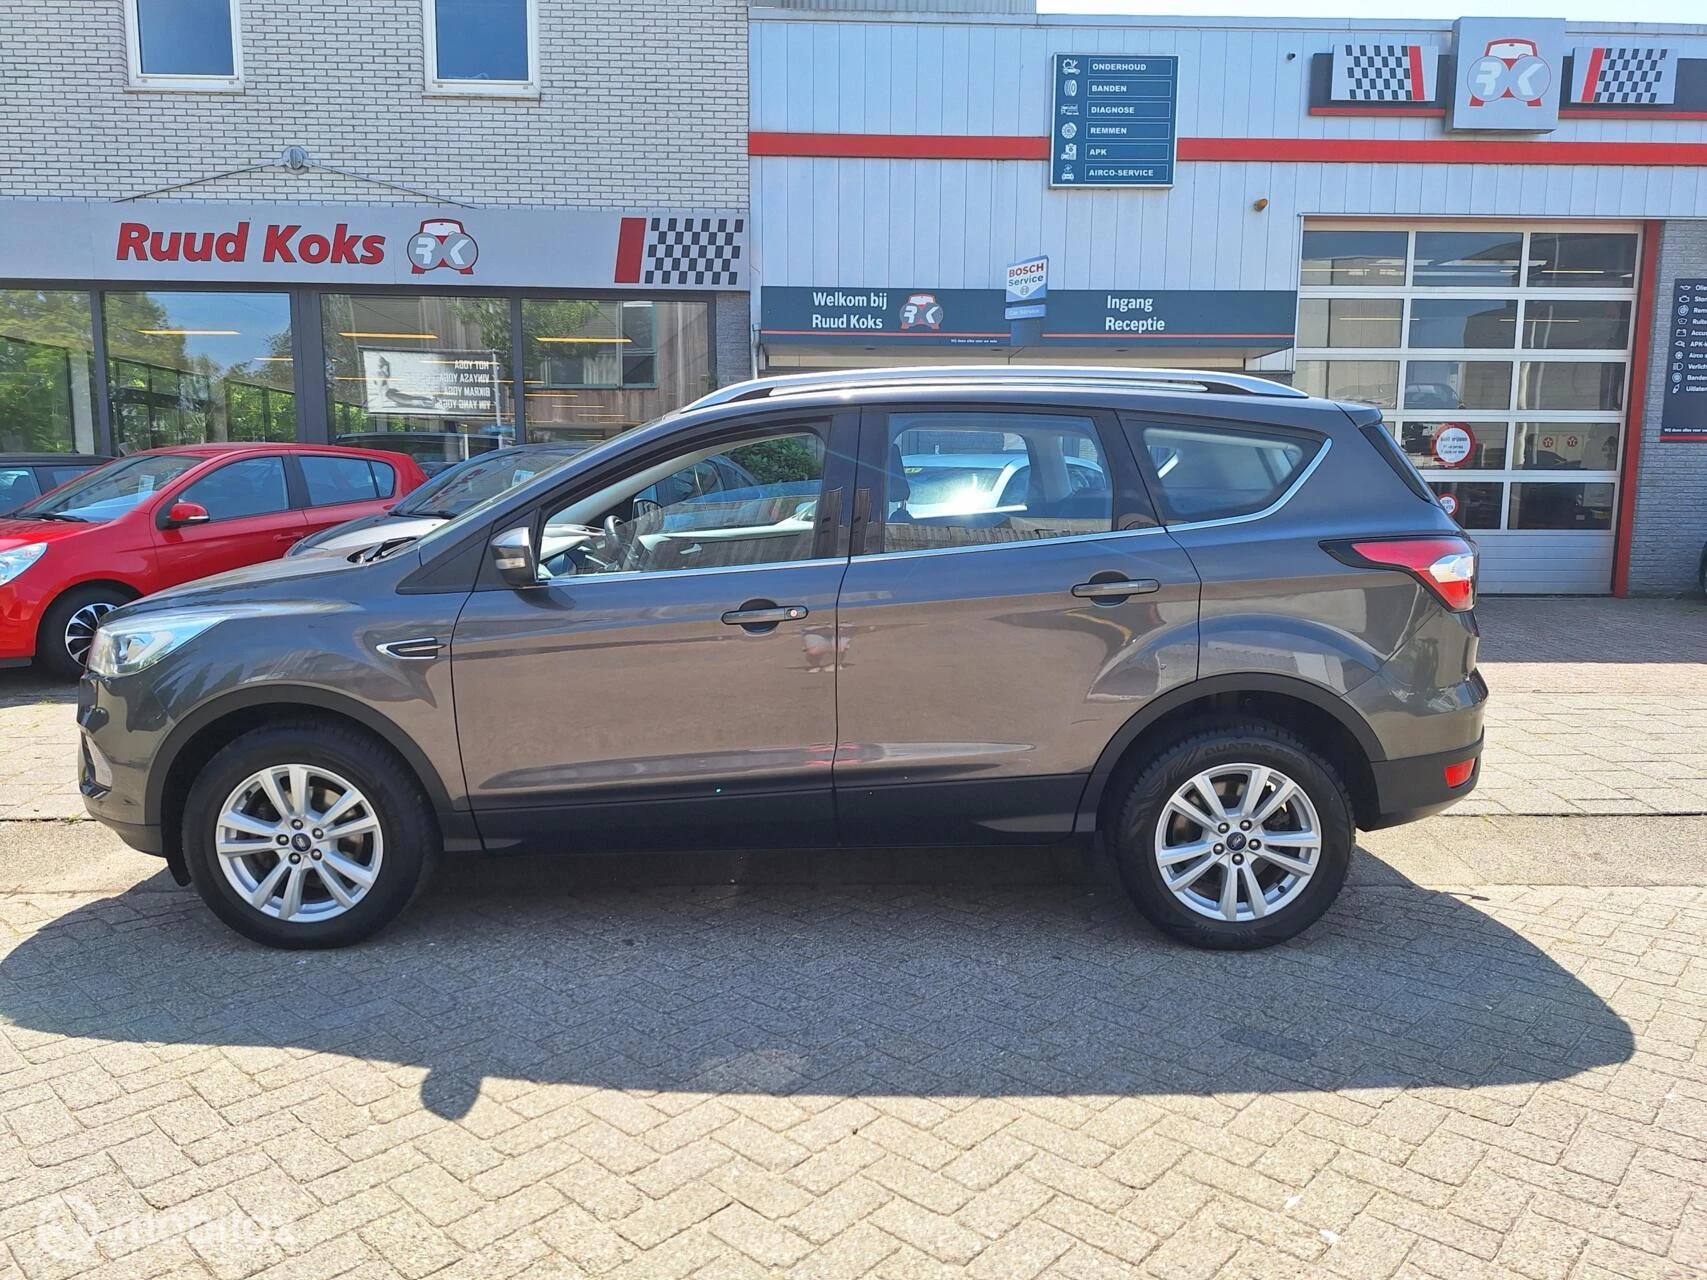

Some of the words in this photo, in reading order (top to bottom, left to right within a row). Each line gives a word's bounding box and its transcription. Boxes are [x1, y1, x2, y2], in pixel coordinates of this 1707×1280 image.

[1092, 63, 1147, 71] ONDERHOUD
[1091, 106, 1135, 114] DIAGNOSE
[1089, 148, 1107, 156] APK
[1088, 169, 1154, 177] AIRCO-SERVICE
[116, 221, 250, 263] Ruud
[263, 223, 386, 265] Koks
[1008, 262, 1045, 278] BOSCH
[1008, 274, 1044, 287] Service
[812, 292, 867, 307] Welkom
[870, 292, 887, 310] bij
[1106, 295, 1153, 312] Ingang
[812, 314, 847, 329] Ruud
[850, 315, 883, 329] Koks
[1105, 316, 1165, 333] Receptie
